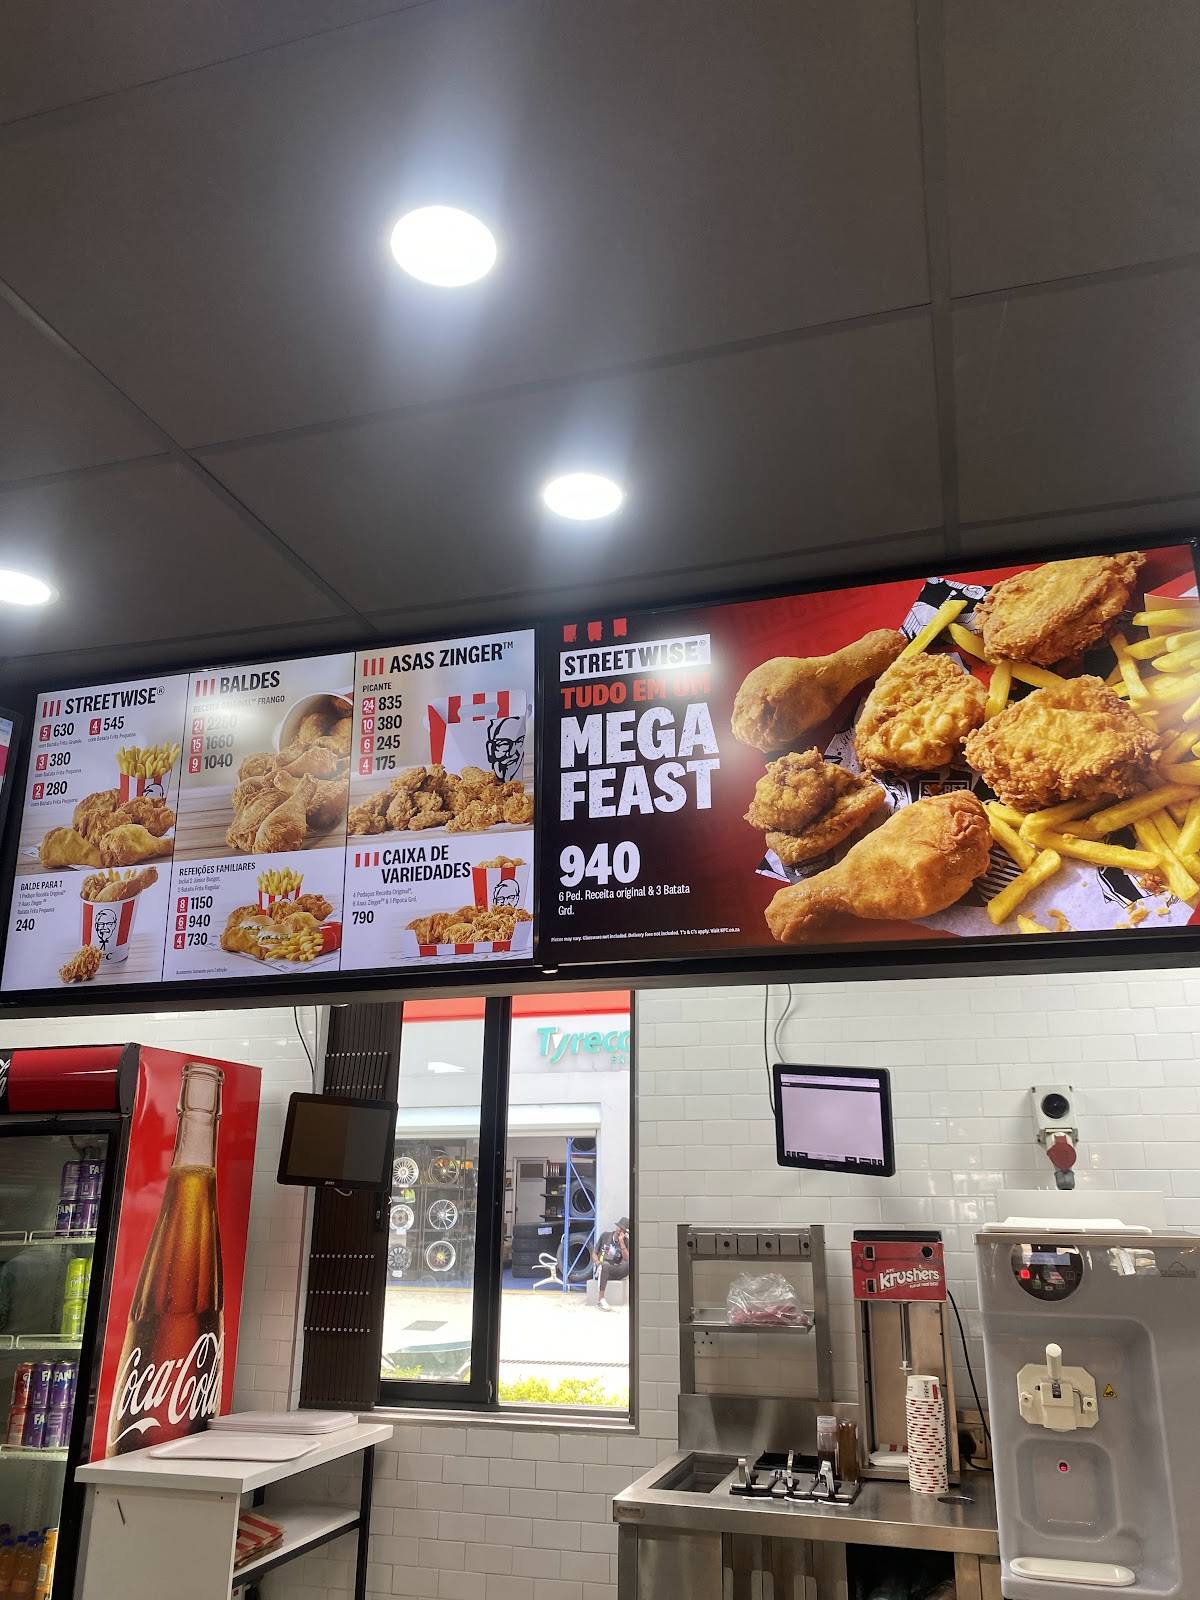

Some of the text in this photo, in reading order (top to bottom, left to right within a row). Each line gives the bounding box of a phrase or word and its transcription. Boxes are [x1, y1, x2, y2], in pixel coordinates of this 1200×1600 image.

[389, 651, 435, 674] ASAS
[219, 670, 281, 694] BALDES
[362, 682, 392, 693] PICANTE
[257, 695, 286, 705] FRANGO
[560, 681, 627, 710] TUDO
[632, 677, 667, 702] EM
[363, 694, 402, 712] 24 835
[42, 722, 75, 738] 5 630
[92, 715, 125, 732] 4 545
[363, 714, 403, 731] 10 380
[192, 738, 201, 749] 15
[364, 734, 401, 751] 6 245
[560, 702, 720, 769] MEGA
[39, 751, 71, 767] 3 380
[191, 752, 233, 770] 9 1040
[362, 754, 396, 771] 4 175
[35, 780, 68, 796] 2 280
[559, 758, 721, 821] FEAST
[382, 844, 449, 866] CAIXA DE
[179, 862, 256, 877] REFEIÇÕES FAMILIARES
[381, 861, 471, 884] VARIEDADES
[559, 840, 641, 888] 940
[20, 882, 40, 891] BALDE
[41, 880, 58, 890] PARA
[558, 884, 691, 902] 6 Ped. Receita original & 3 Batata
[180, 896, 213, 910] 8 1150
[558, 904, 575, 916] Grd.
[15, 918, 35, 932] 240
[178, 914, 211, 928] 6 940
[352, 910, 375, 925] 790
[176, 932, 208, 947] 4 730
[879, 1264, 940, 1291] Krushers
